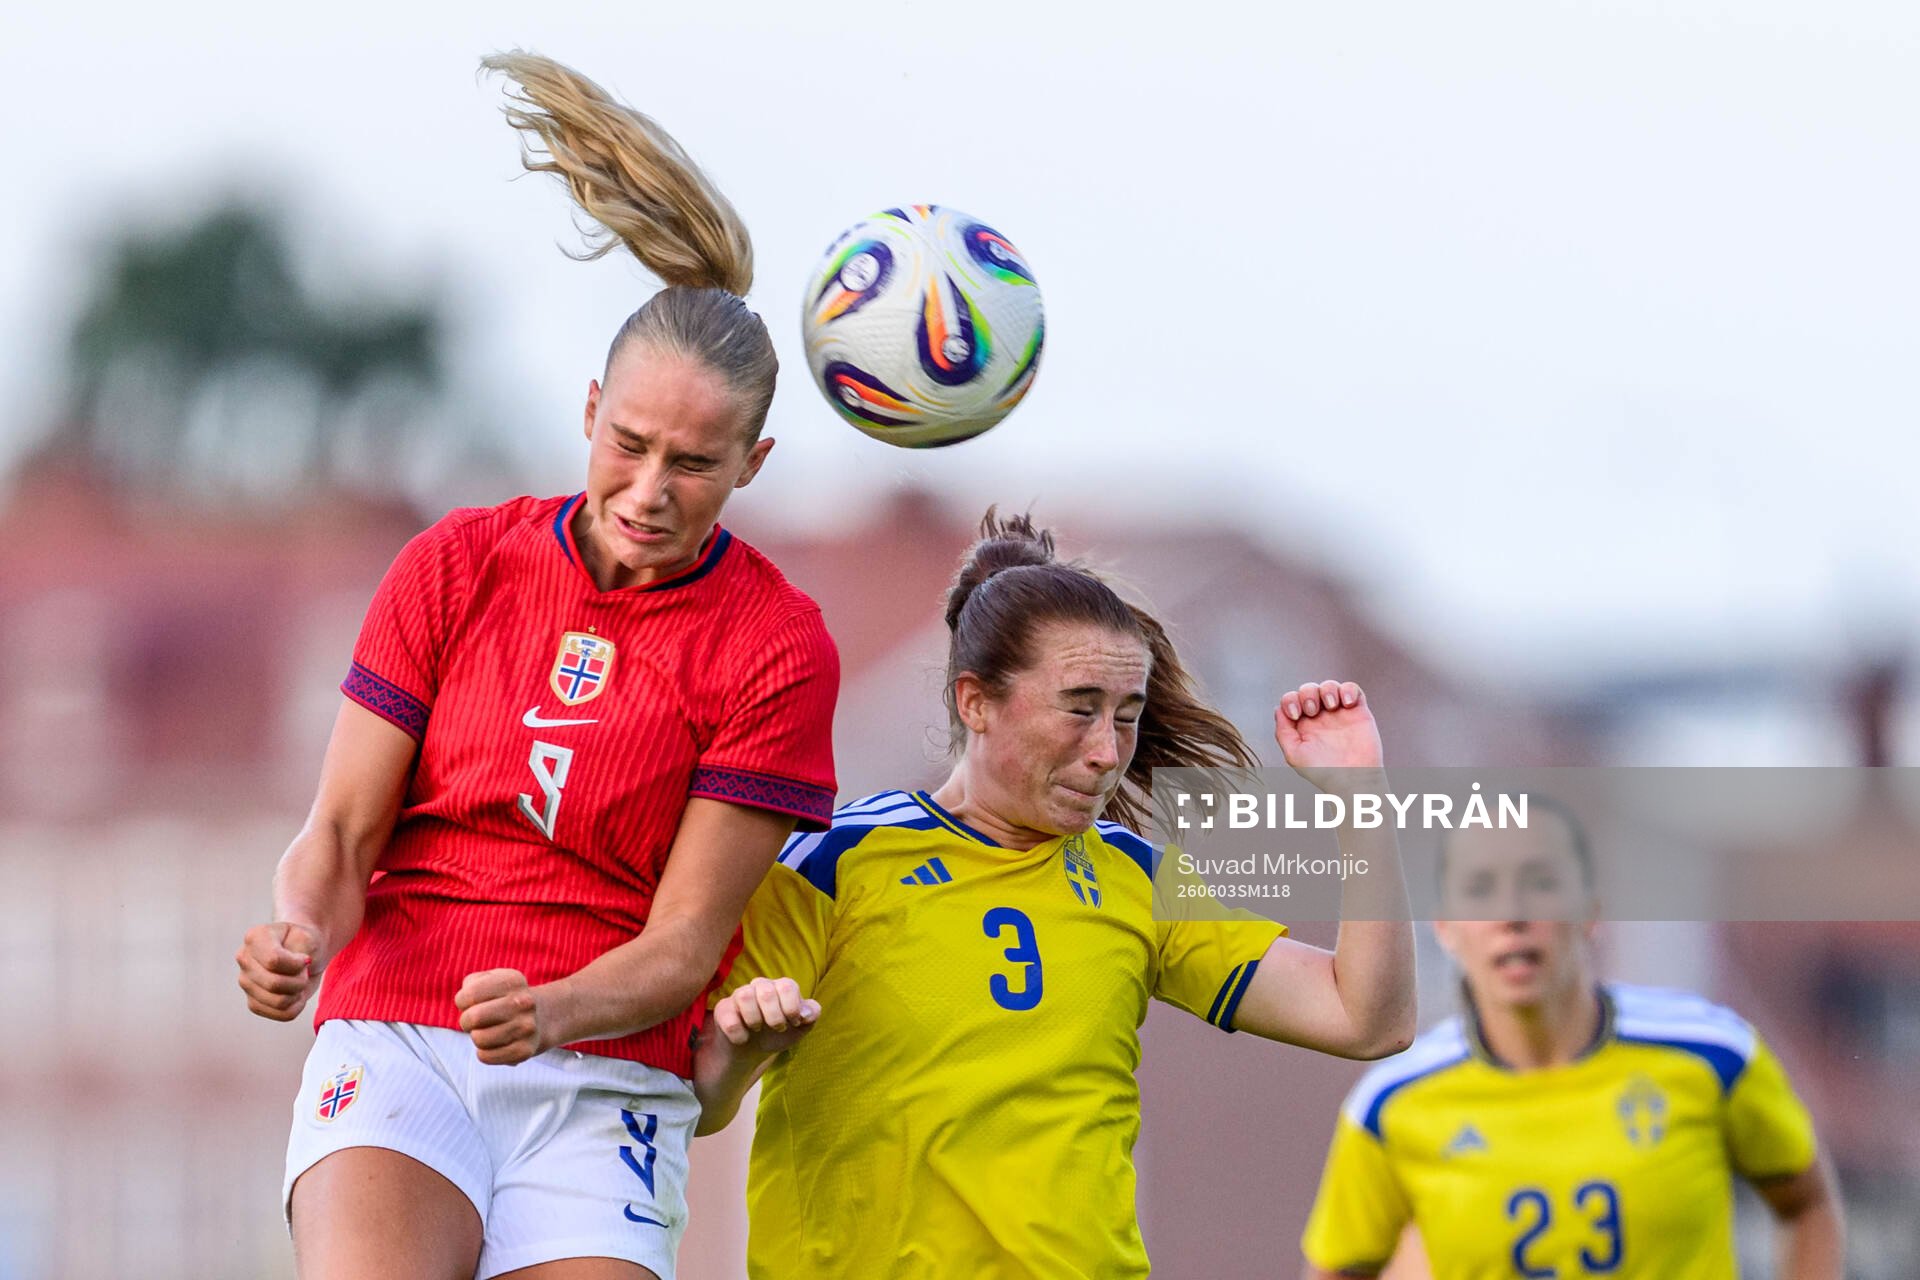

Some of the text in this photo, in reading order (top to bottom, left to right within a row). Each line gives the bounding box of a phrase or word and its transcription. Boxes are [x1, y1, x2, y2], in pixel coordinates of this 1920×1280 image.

[517, 740, 574, 841] 9
[982, 906, 1043, 1011] 3
[619, 1108, 658, 1199] 9
[1508, 1181, 1623, 1279] 23
